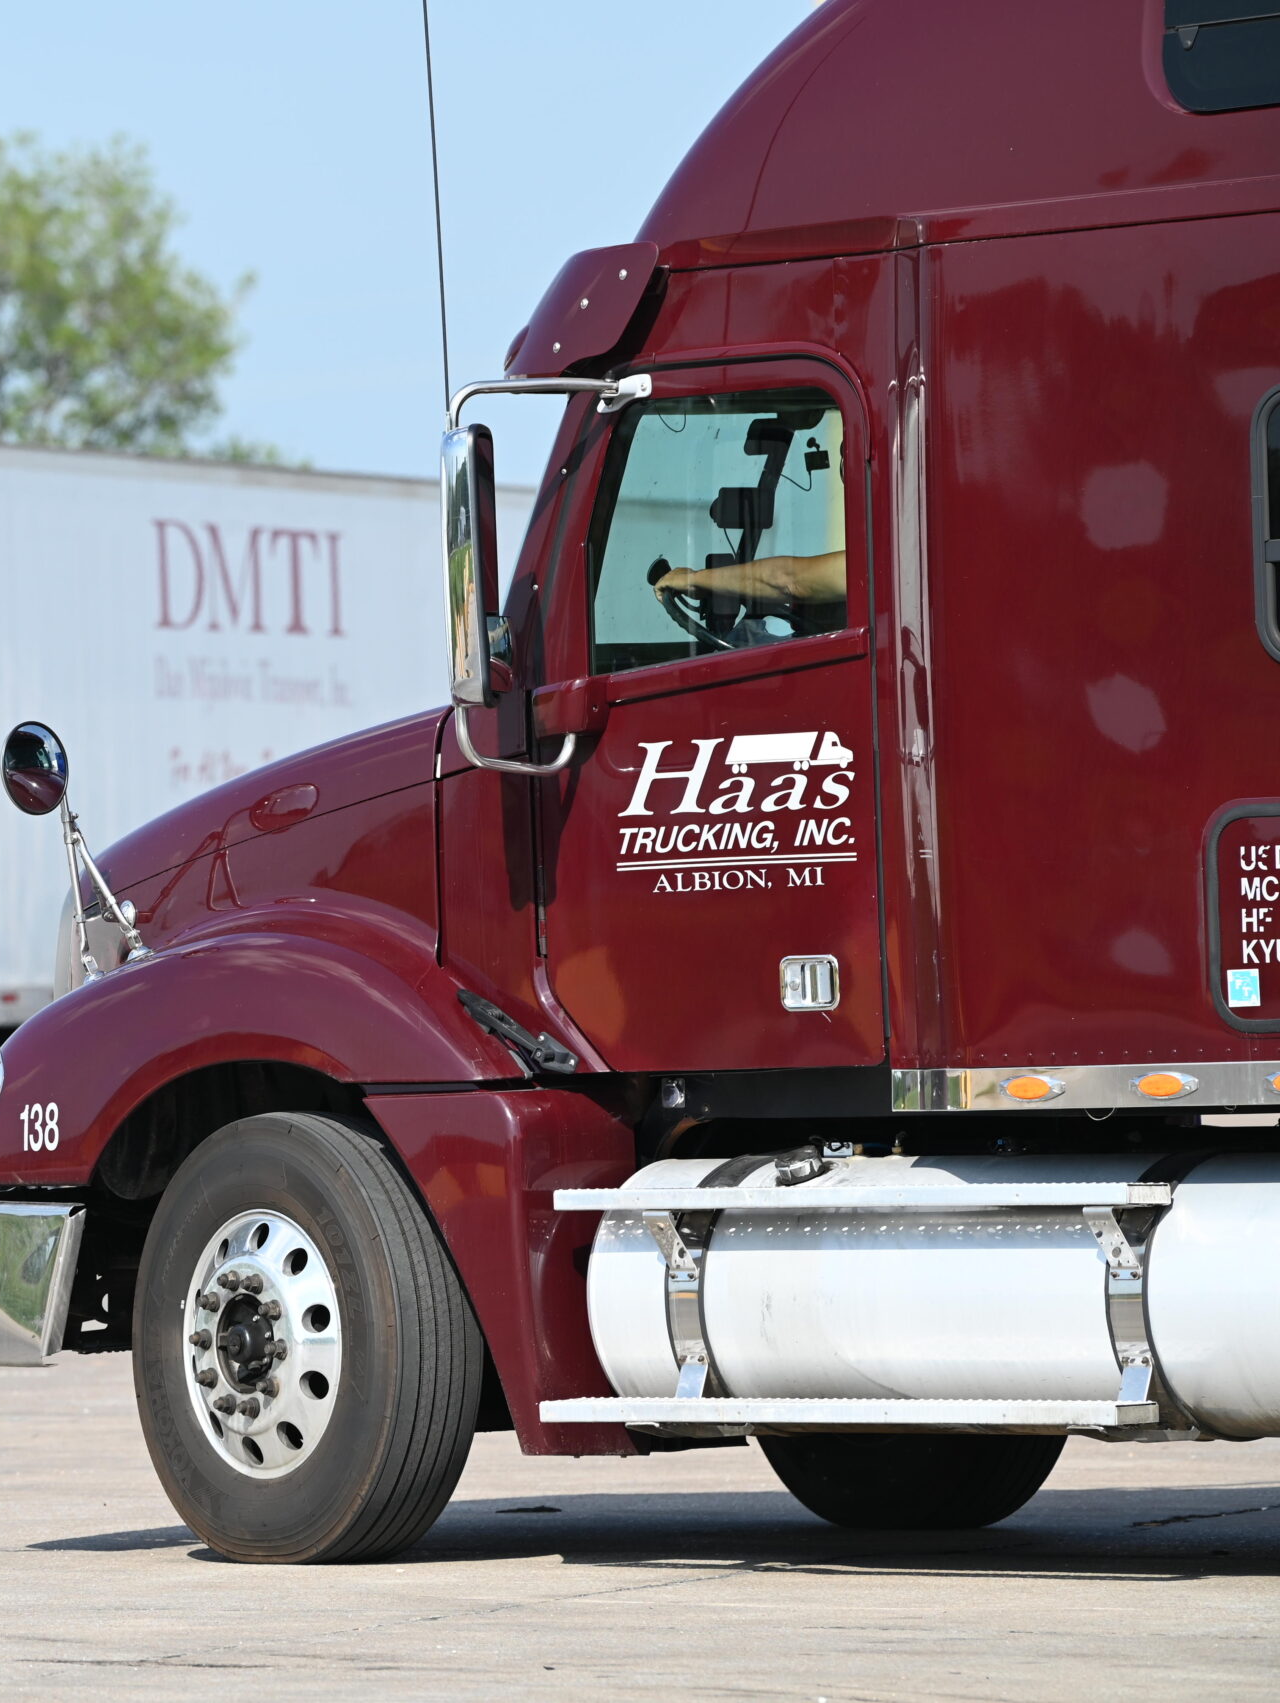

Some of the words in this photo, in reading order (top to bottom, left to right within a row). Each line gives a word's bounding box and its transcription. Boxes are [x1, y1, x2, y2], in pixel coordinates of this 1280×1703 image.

[151, 517, 345, 637] DMTI
[618, 738, 855, 817] Haas
[619, 821, 779, 853] TRUCKING,
[794, 817, 856, 846] INC.
[653, 869, 772, 893] ALBION,
[786, 867, 825, 887] MI
[20, 1102, 59, 1152] 138
